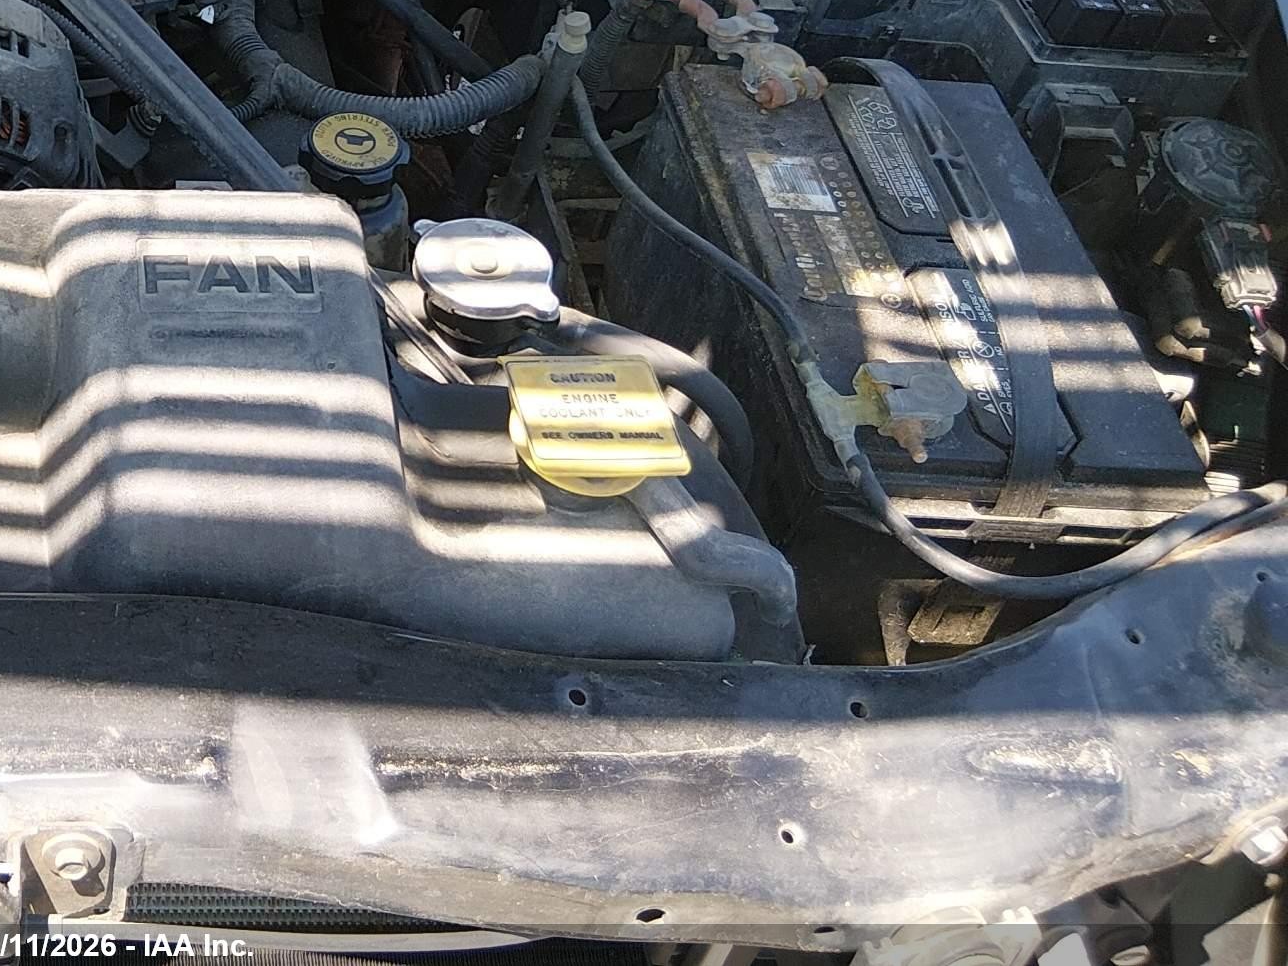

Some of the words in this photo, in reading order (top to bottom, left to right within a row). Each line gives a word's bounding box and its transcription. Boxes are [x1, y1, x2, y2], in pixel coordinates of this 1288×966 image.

[143, 255, 314, 294] FAN
[550, 373, 617, 383] CAUTION
[561, 394, 620, 404] ENGINE
[539, 407, 606, 419] COOLANT
[541, 431, 563, 440] SEE
[619, 431, 664, 441] MANUAL
